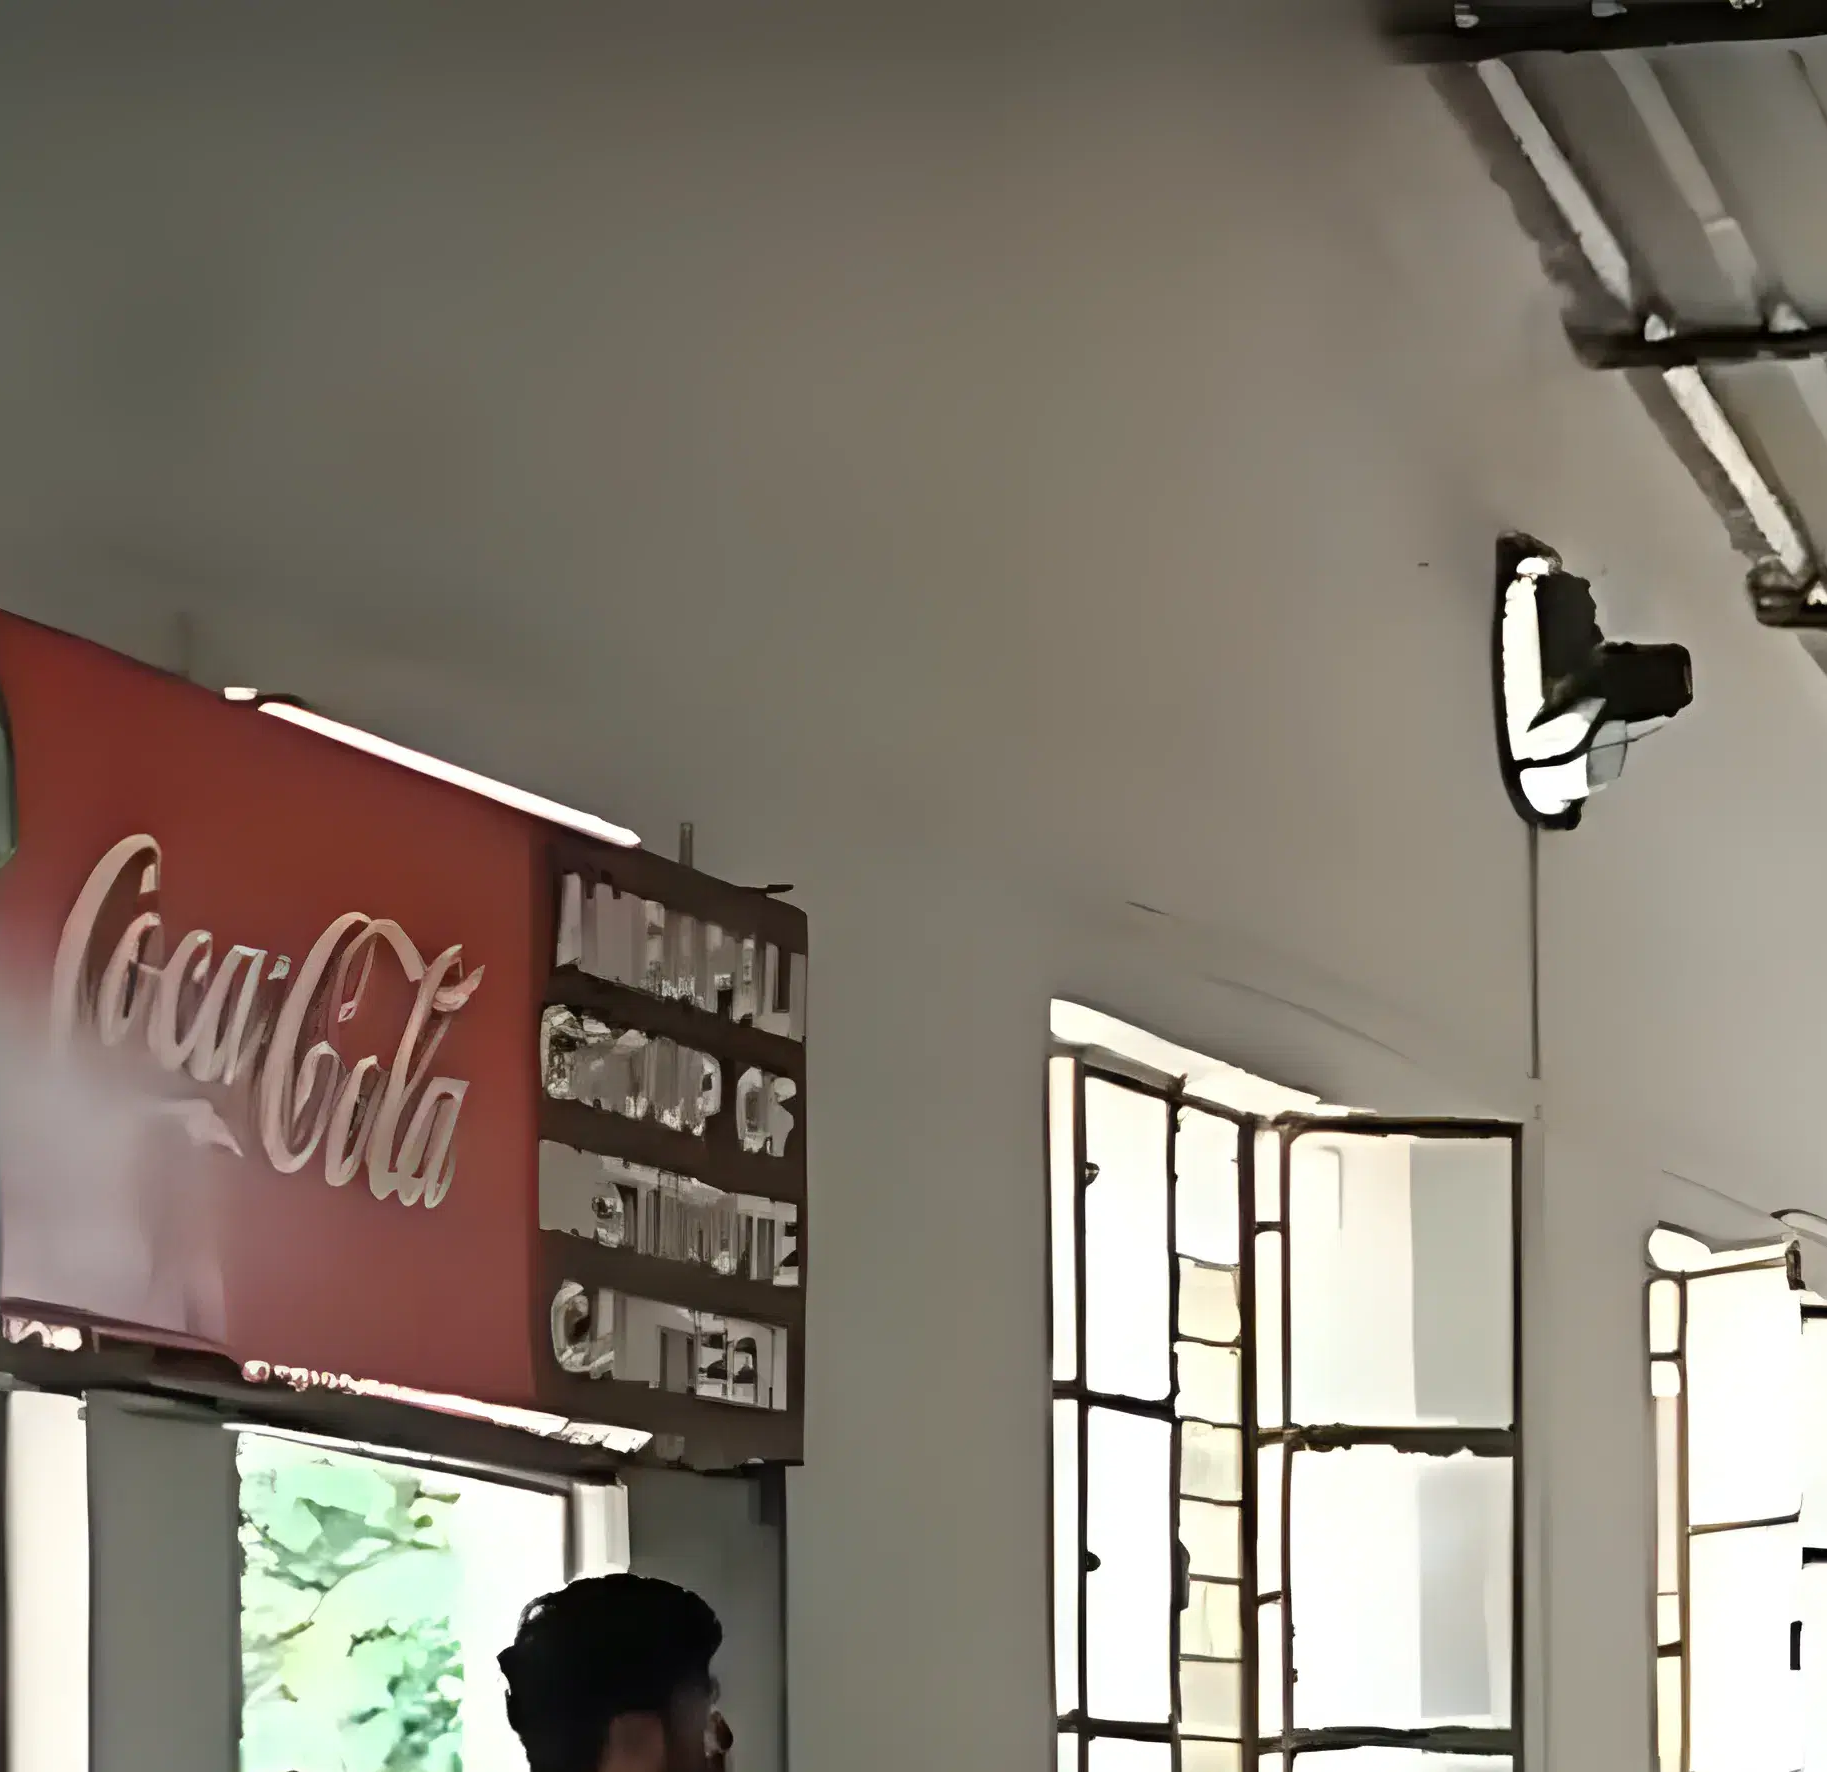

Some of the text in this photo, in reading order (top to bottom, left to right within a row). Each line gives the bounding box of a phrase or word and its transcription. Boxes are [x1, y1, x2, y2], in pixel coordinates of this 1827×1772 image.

[557, 871, 807, 1043] AMBAPALI
[541, 1004, 796, 1157] GROUP OF
[551, 1279, 788, 1412] CANTEEN
